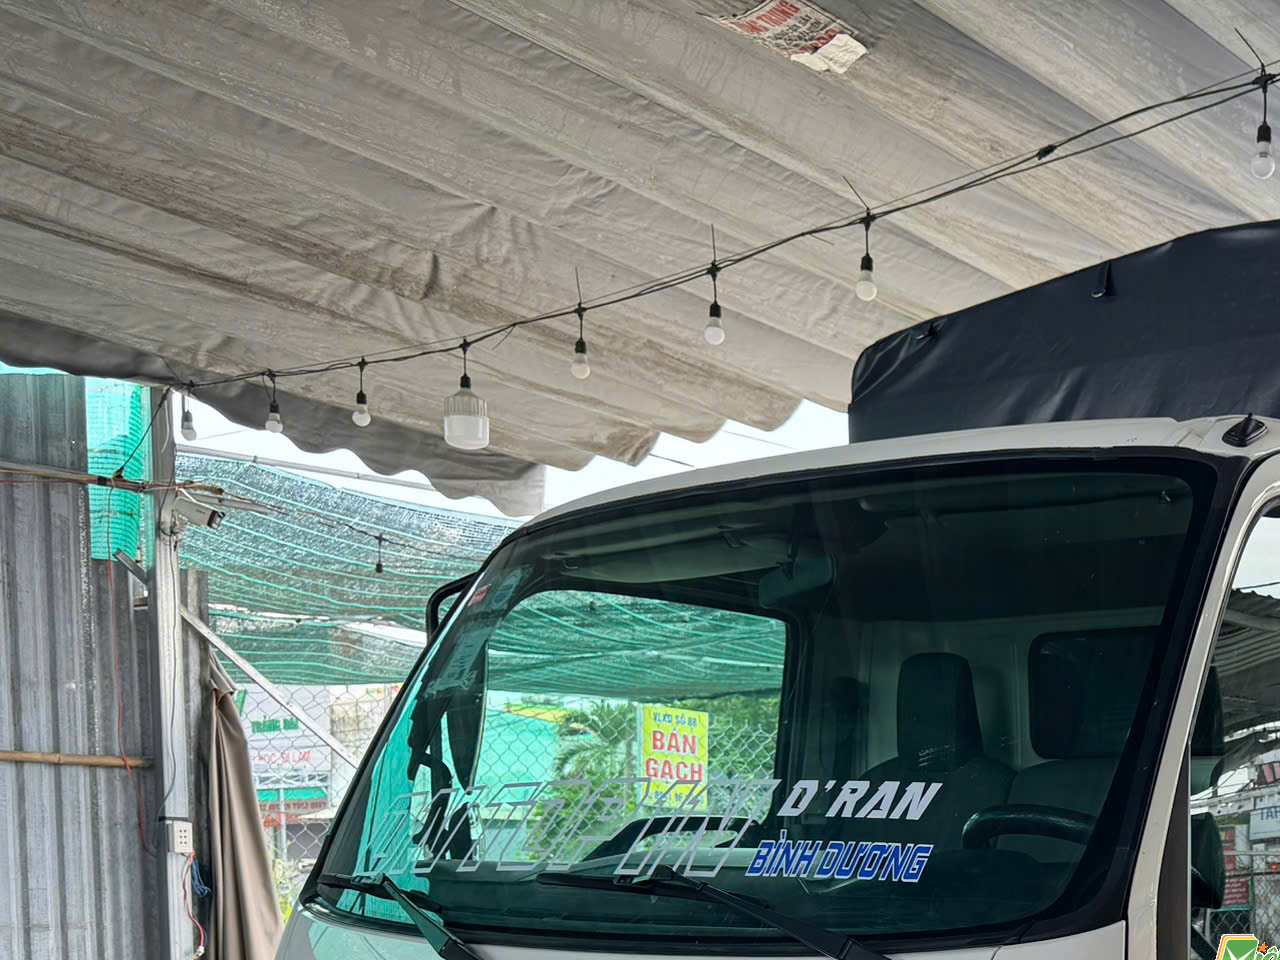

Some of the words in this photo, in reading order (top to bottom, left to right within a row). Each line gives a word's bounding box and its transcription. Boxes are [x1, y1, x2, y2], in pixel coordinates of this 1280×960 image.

[652, 727, 697, 755] BÁN
[645, 758, 703, 784] GẠCH
[776, 779, 943, 821] D'RAN
[745, 829, 823, 878] BÌNH
[813, 840, 934, 883] DƯƠNG
